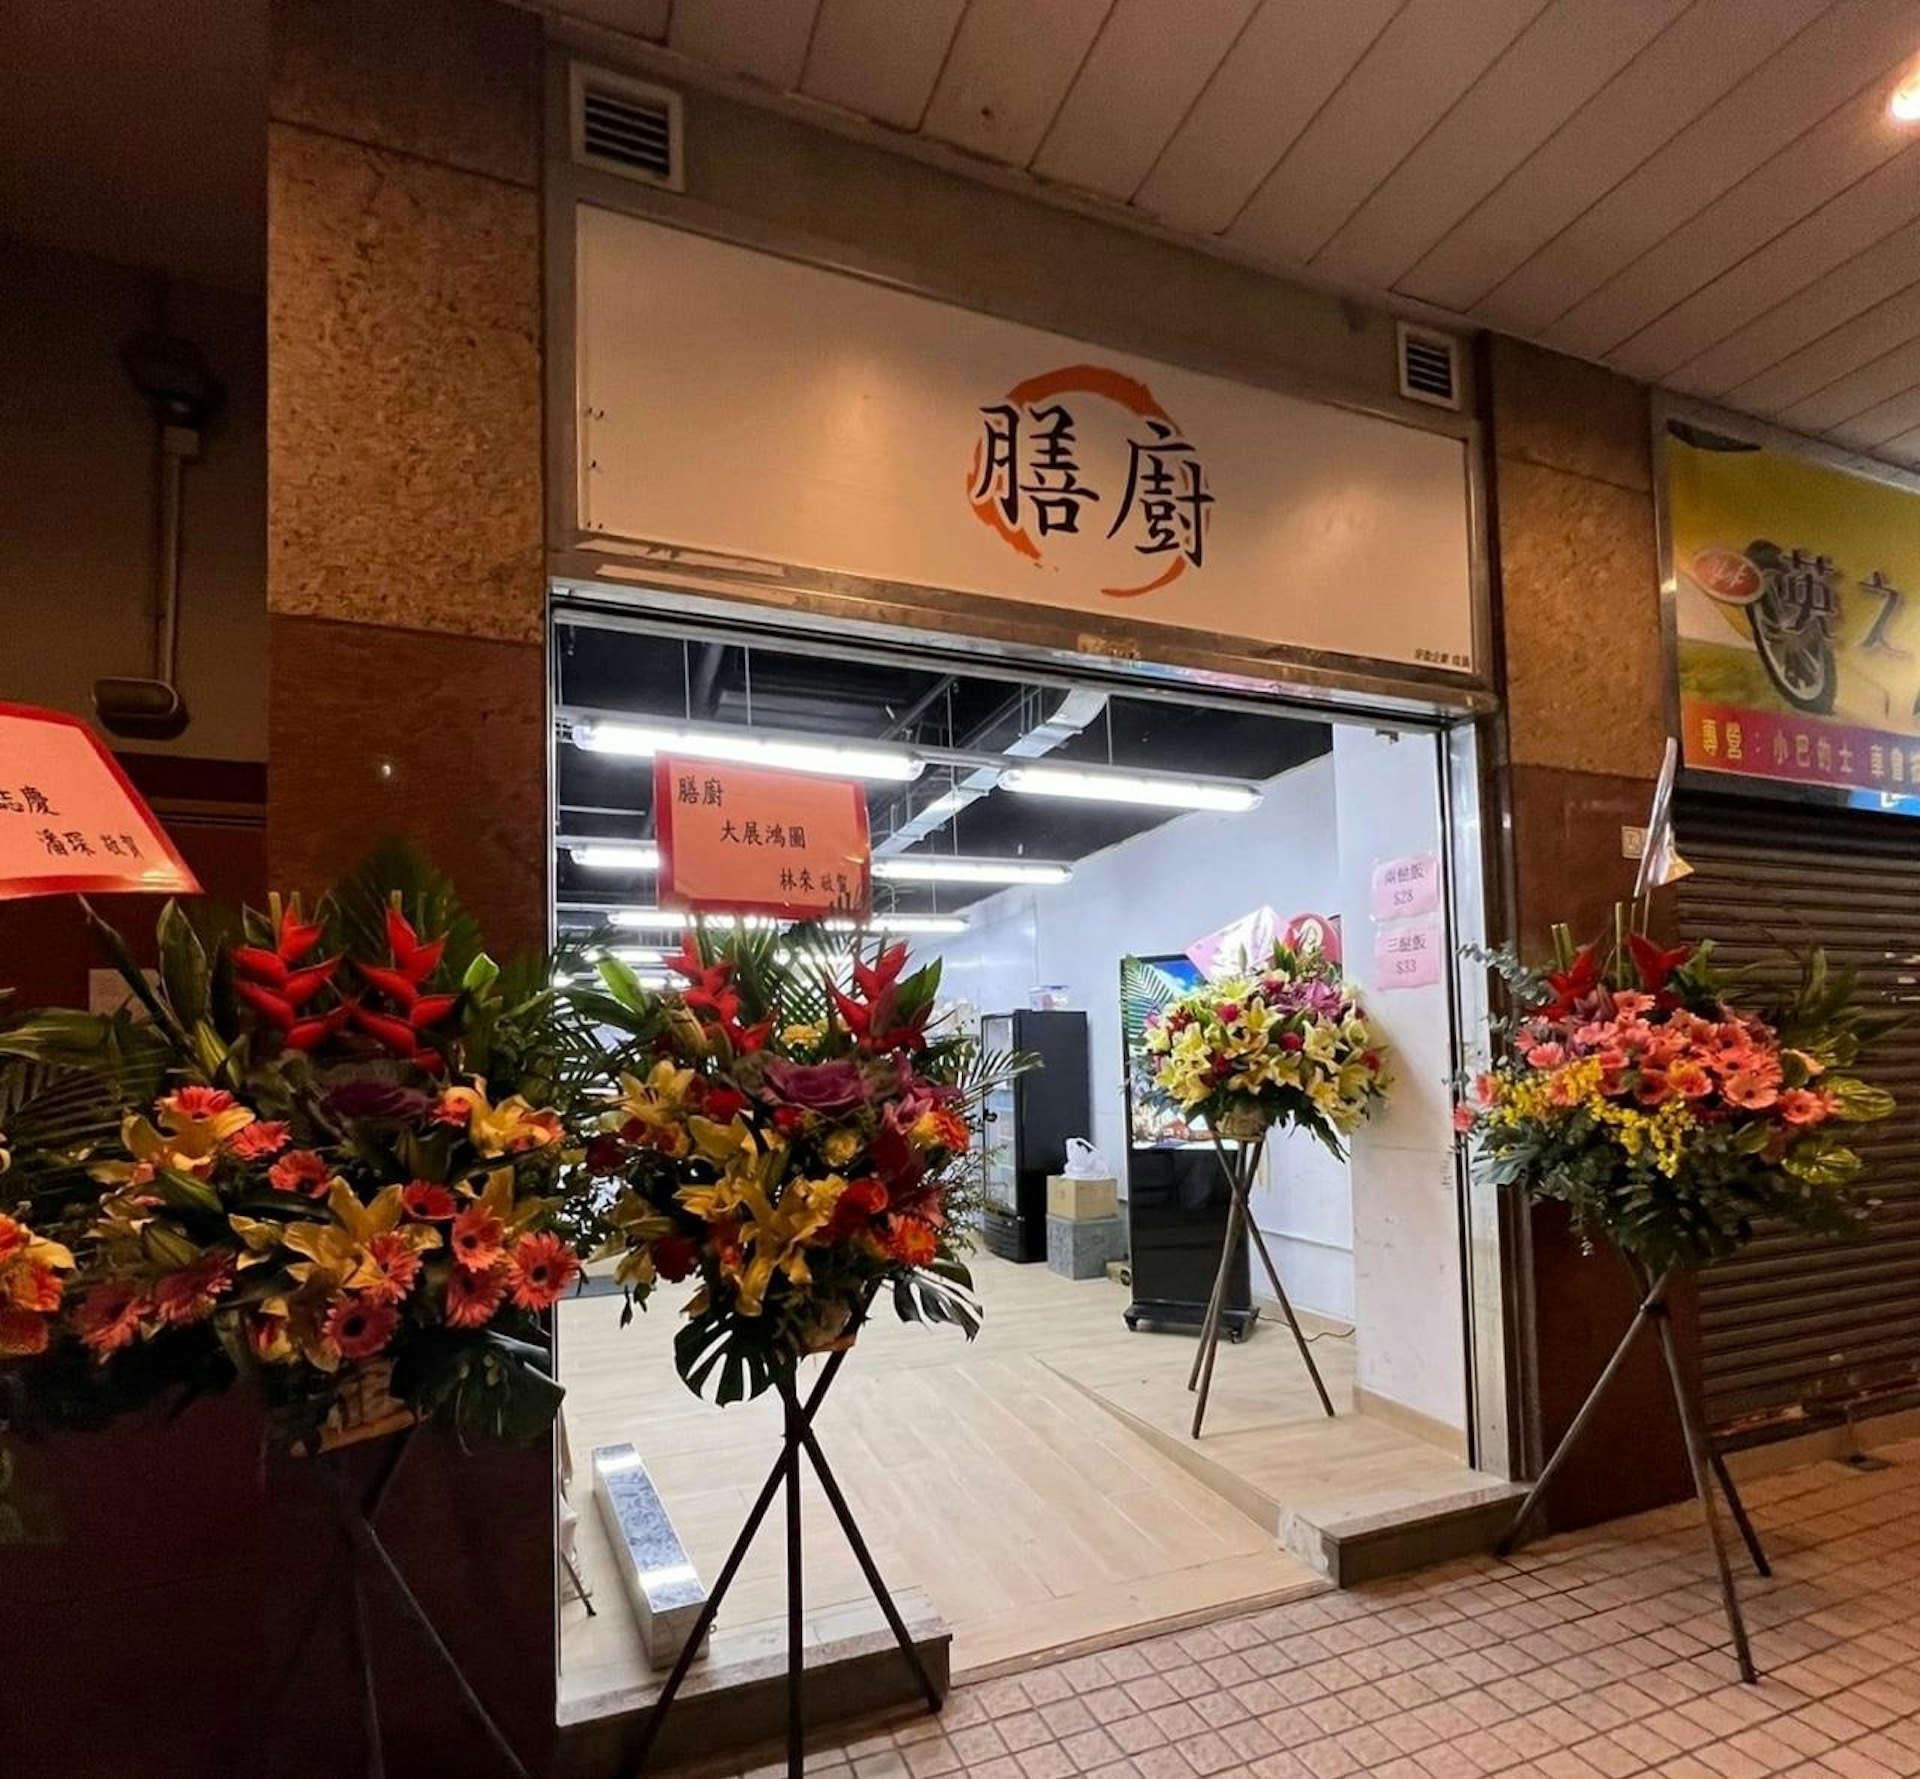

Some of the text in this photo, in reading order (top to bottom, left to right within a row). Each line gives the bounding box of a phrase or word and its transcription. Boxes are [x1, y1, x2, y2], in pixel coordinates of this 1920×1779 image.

[976, 404, 1216, 569] 膳廚
[677, 774, 723, 807] 膳廚
[719, 819, 807, 849] 大展鴻圖
